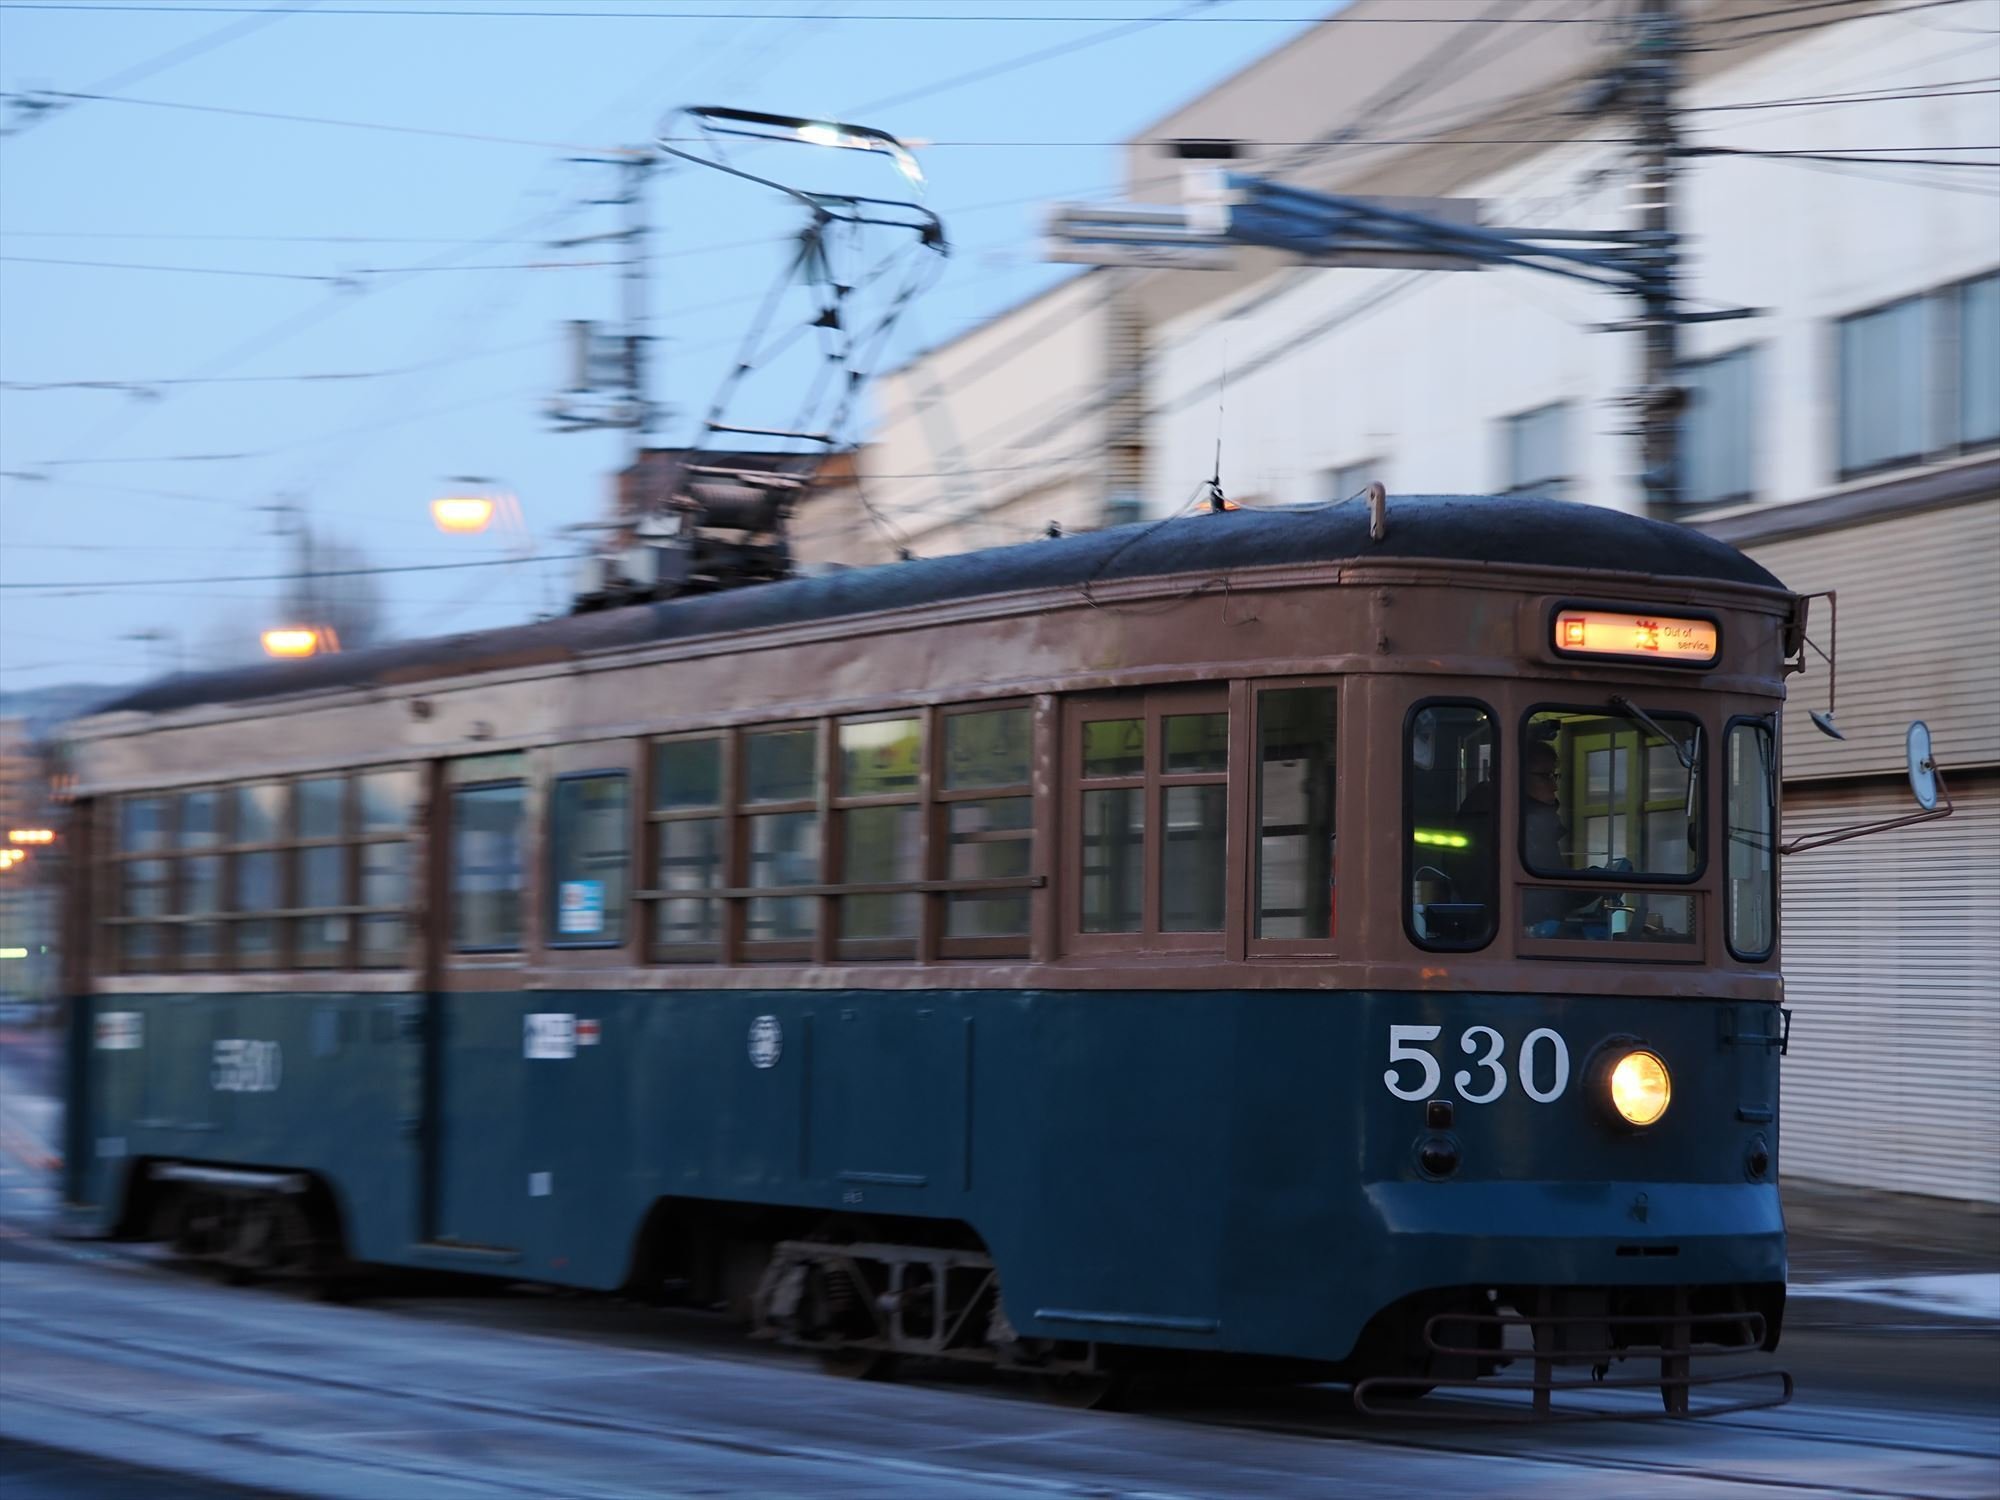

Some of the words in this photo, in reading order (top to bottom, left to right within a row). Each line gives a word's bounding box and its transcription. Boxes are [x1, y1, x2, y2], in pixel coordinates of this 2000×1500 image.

[1664, 626, 1681, 637] Out
[1683, 627, 1693, 637] of
[1678, 639, 1710, 651] service
[1383, 1024, 1570, 1104] 530
